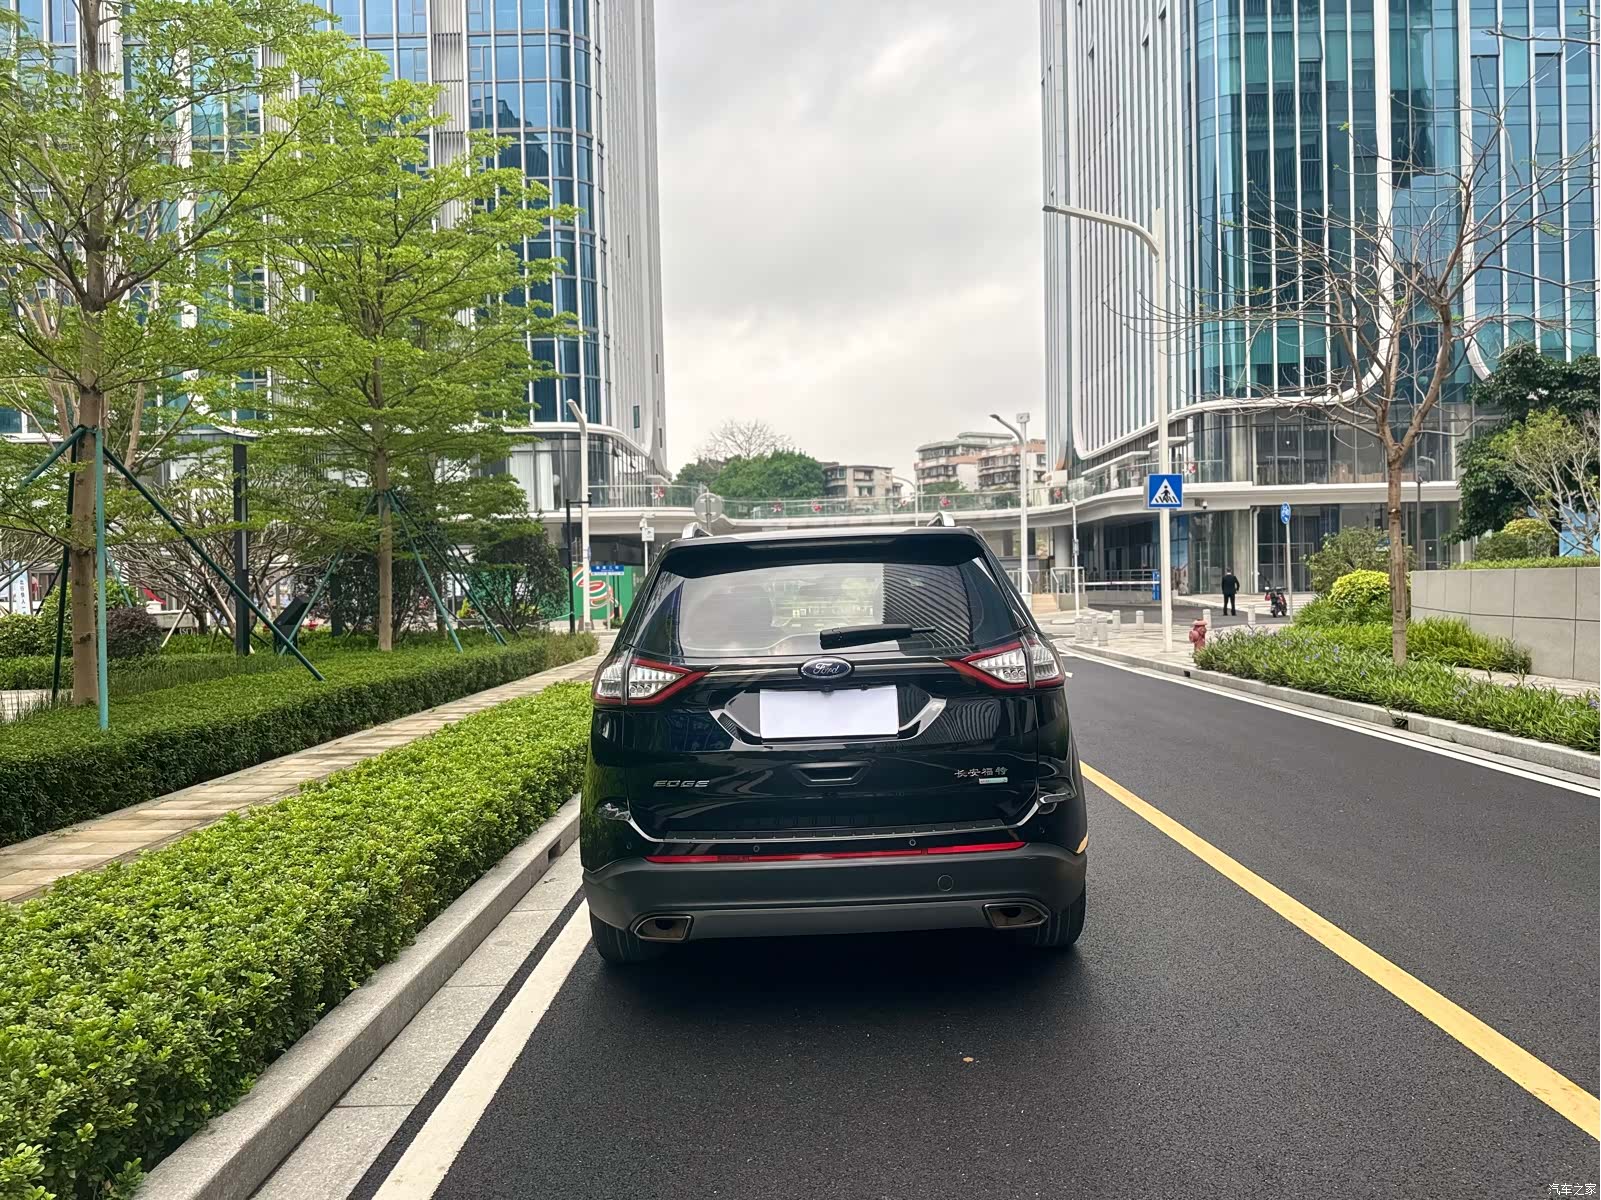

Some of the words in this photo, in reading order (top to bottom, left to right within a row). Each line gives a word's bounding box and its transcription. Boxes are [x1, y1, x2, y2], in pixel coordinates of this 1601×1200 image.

[812, 662, 840, 675] Ford
[953, 766, 1008, 778] 长安福特
[653, 779, 710, 788] EDGE
